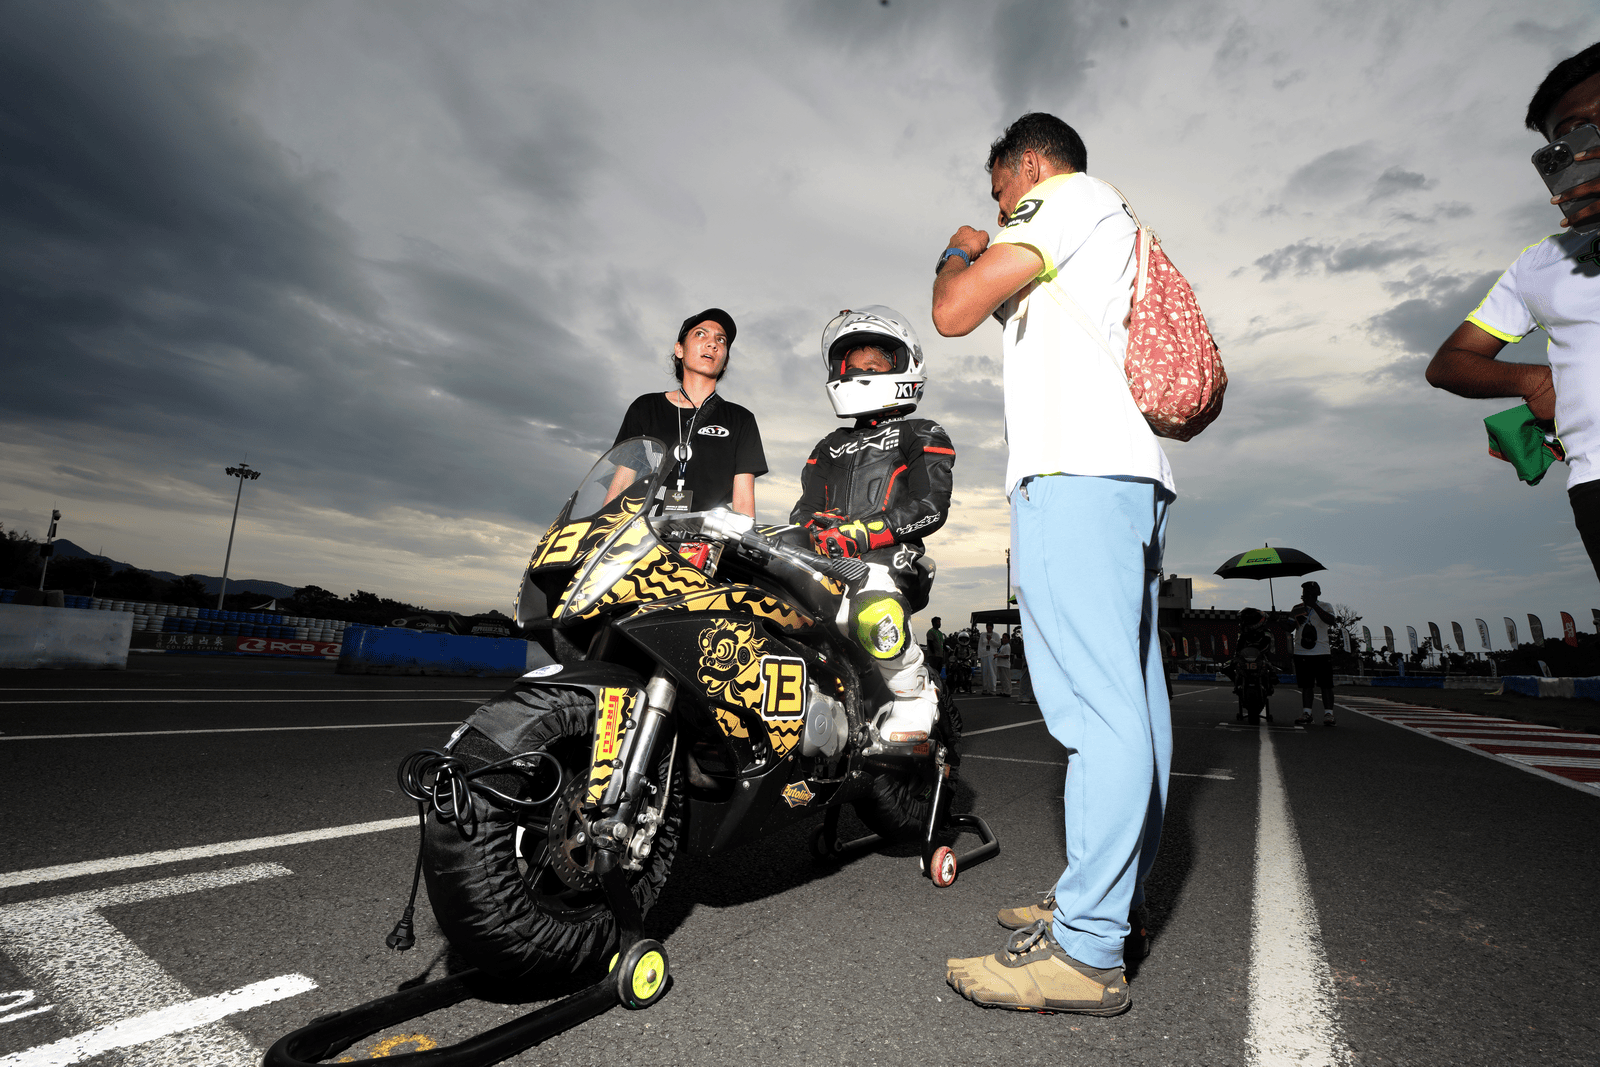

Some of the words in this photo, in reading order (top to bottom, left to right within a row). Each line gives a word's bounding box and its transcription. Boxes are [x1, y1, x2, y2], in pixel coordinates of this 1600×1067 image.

[896, 382, 923, 398] KYT
[533, 521, 592, 569] 13
[270, 641, 315, 653] RCB
[763, 660, 804, 714] 13
[602, 694, 620, 754] PIRELLI
